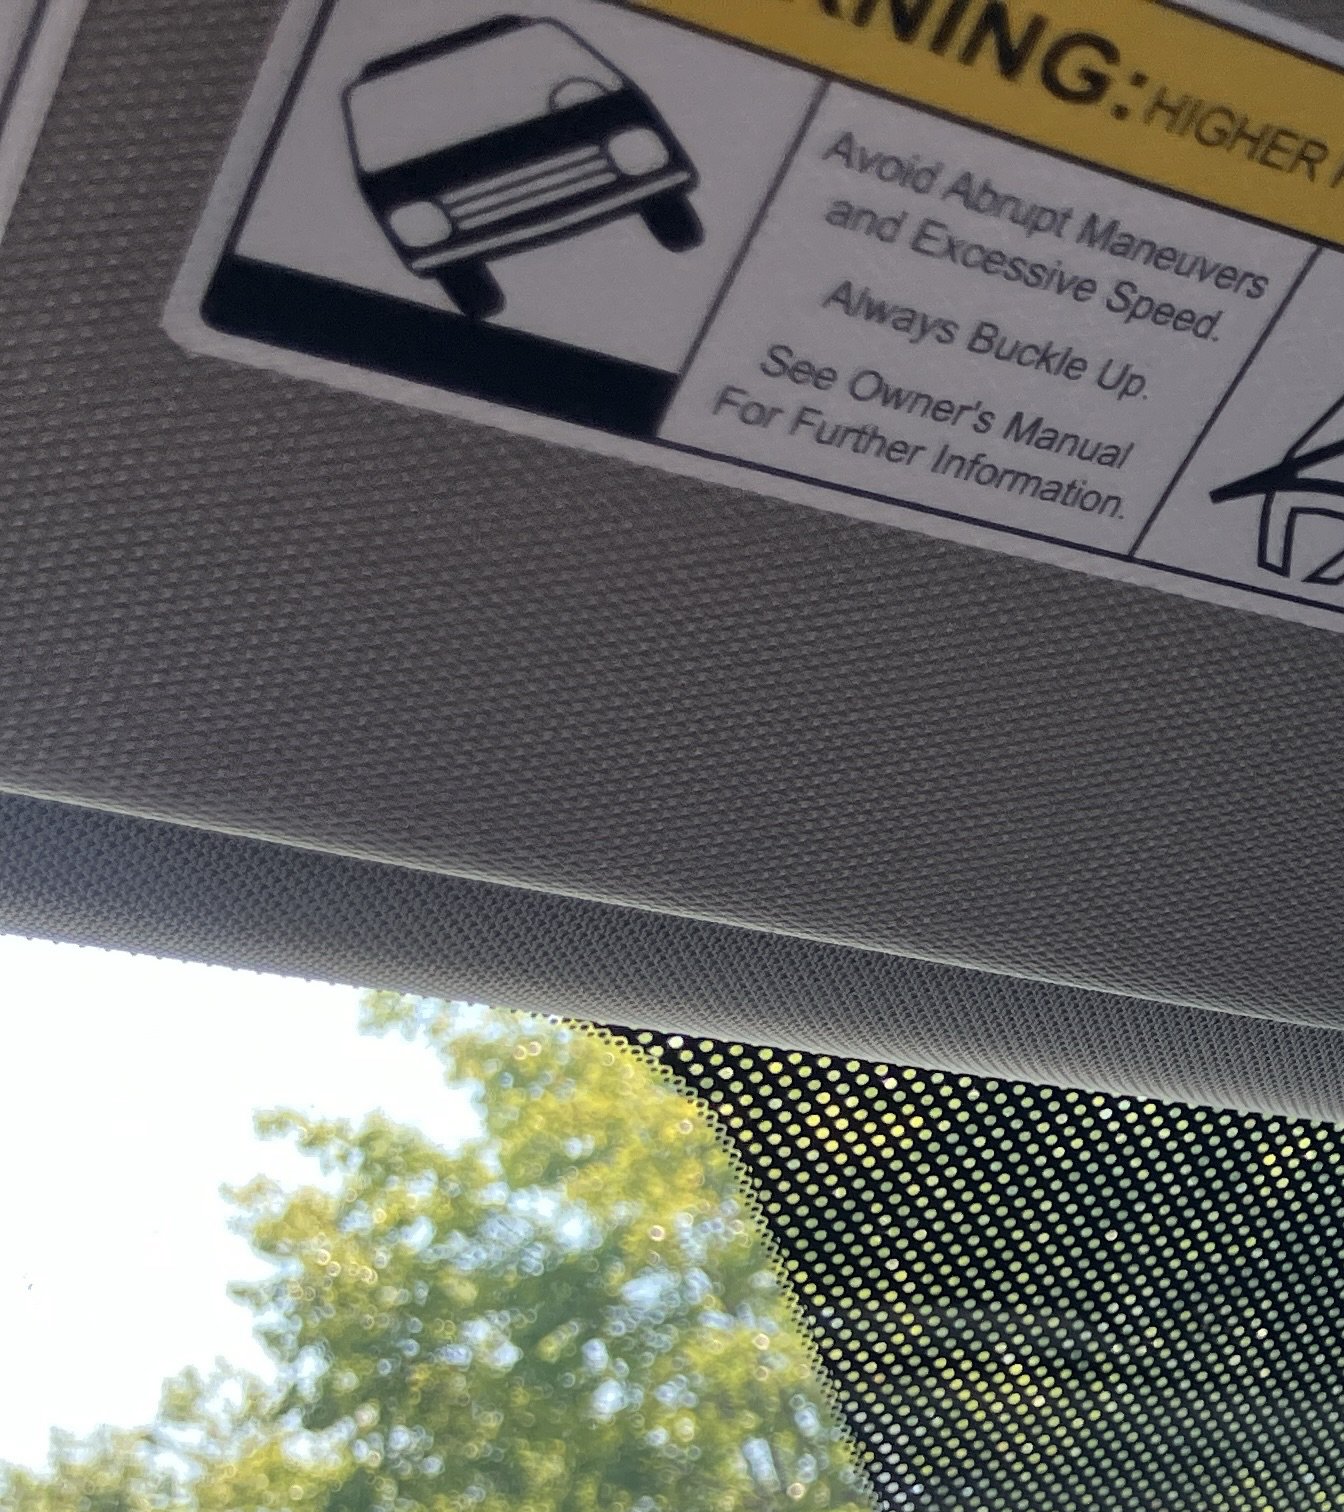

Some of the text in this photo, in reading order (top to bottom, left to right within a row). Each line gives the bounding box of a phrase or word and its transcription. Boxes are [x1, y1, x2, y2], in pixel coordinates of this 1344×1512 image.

[1143, 85, 1329, 182] HIGHER
[822, 131, 1270, 300] Avoid Abrupt Maneuvers
[824, 199, 1223, 342] and Excessive Speed.
[822, 280, 1150, 400] Always Buckle Up.
[712, 385, 1126, 520] For Further Information.
[760, 344, 1136, 470] See Owner's Manual
